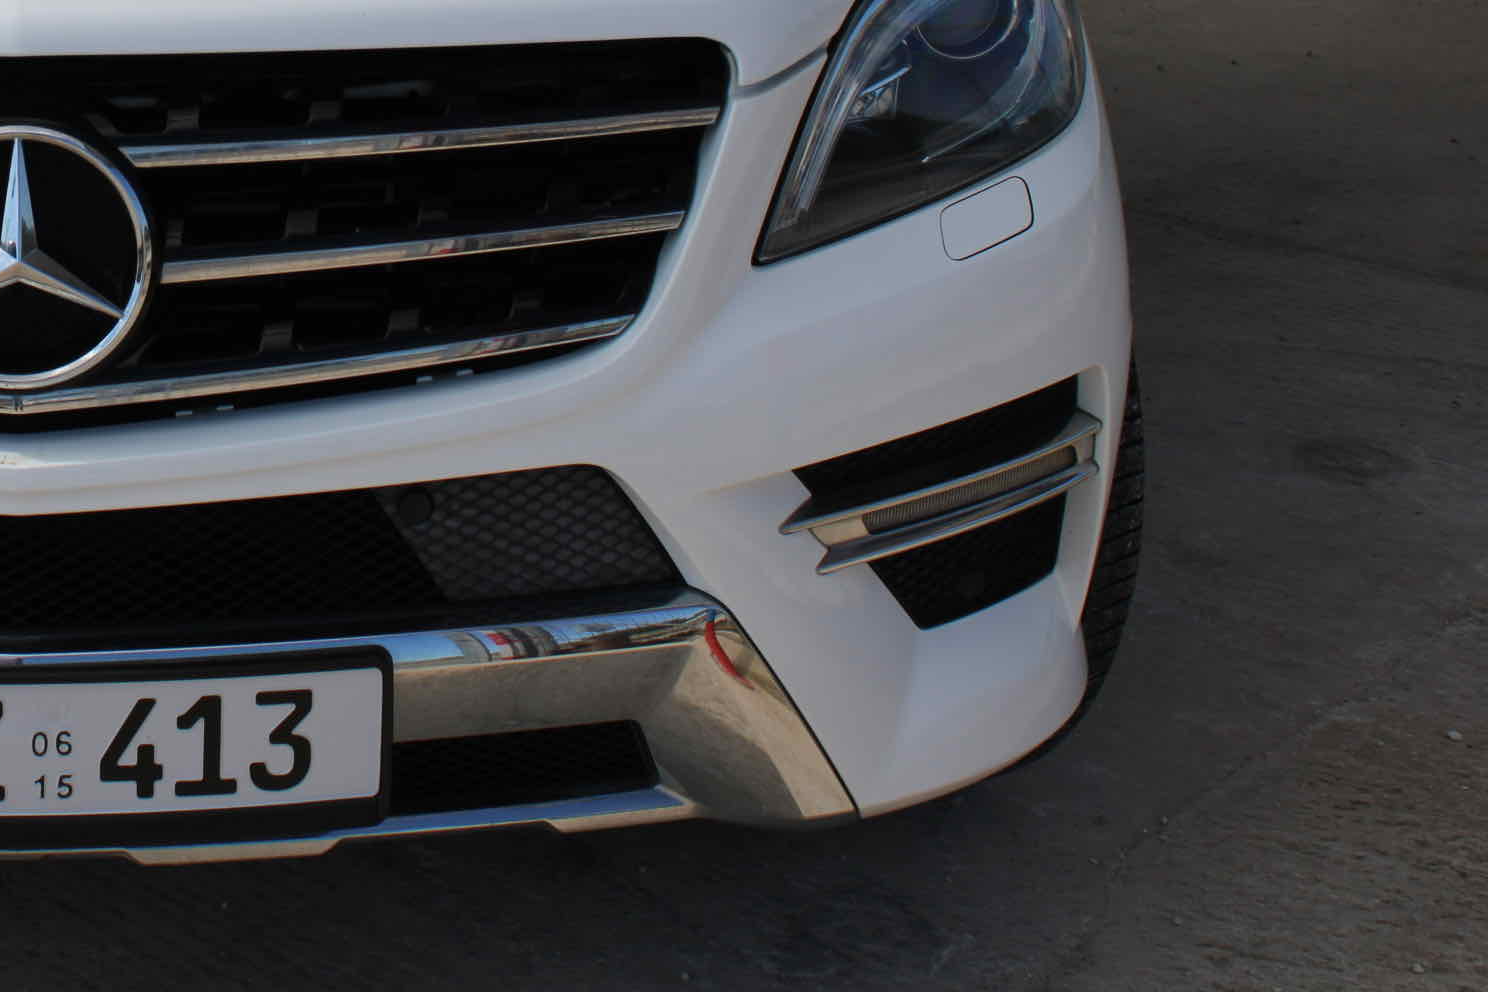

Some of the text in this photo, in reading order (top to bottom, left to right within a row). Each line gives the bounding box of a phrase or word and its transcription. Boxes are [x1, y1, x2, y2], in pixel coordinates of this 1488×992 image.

[31, 730, 73, 758] 06
[99, 689, 313, 799] 413
[34, 774, 73, 800] 15
